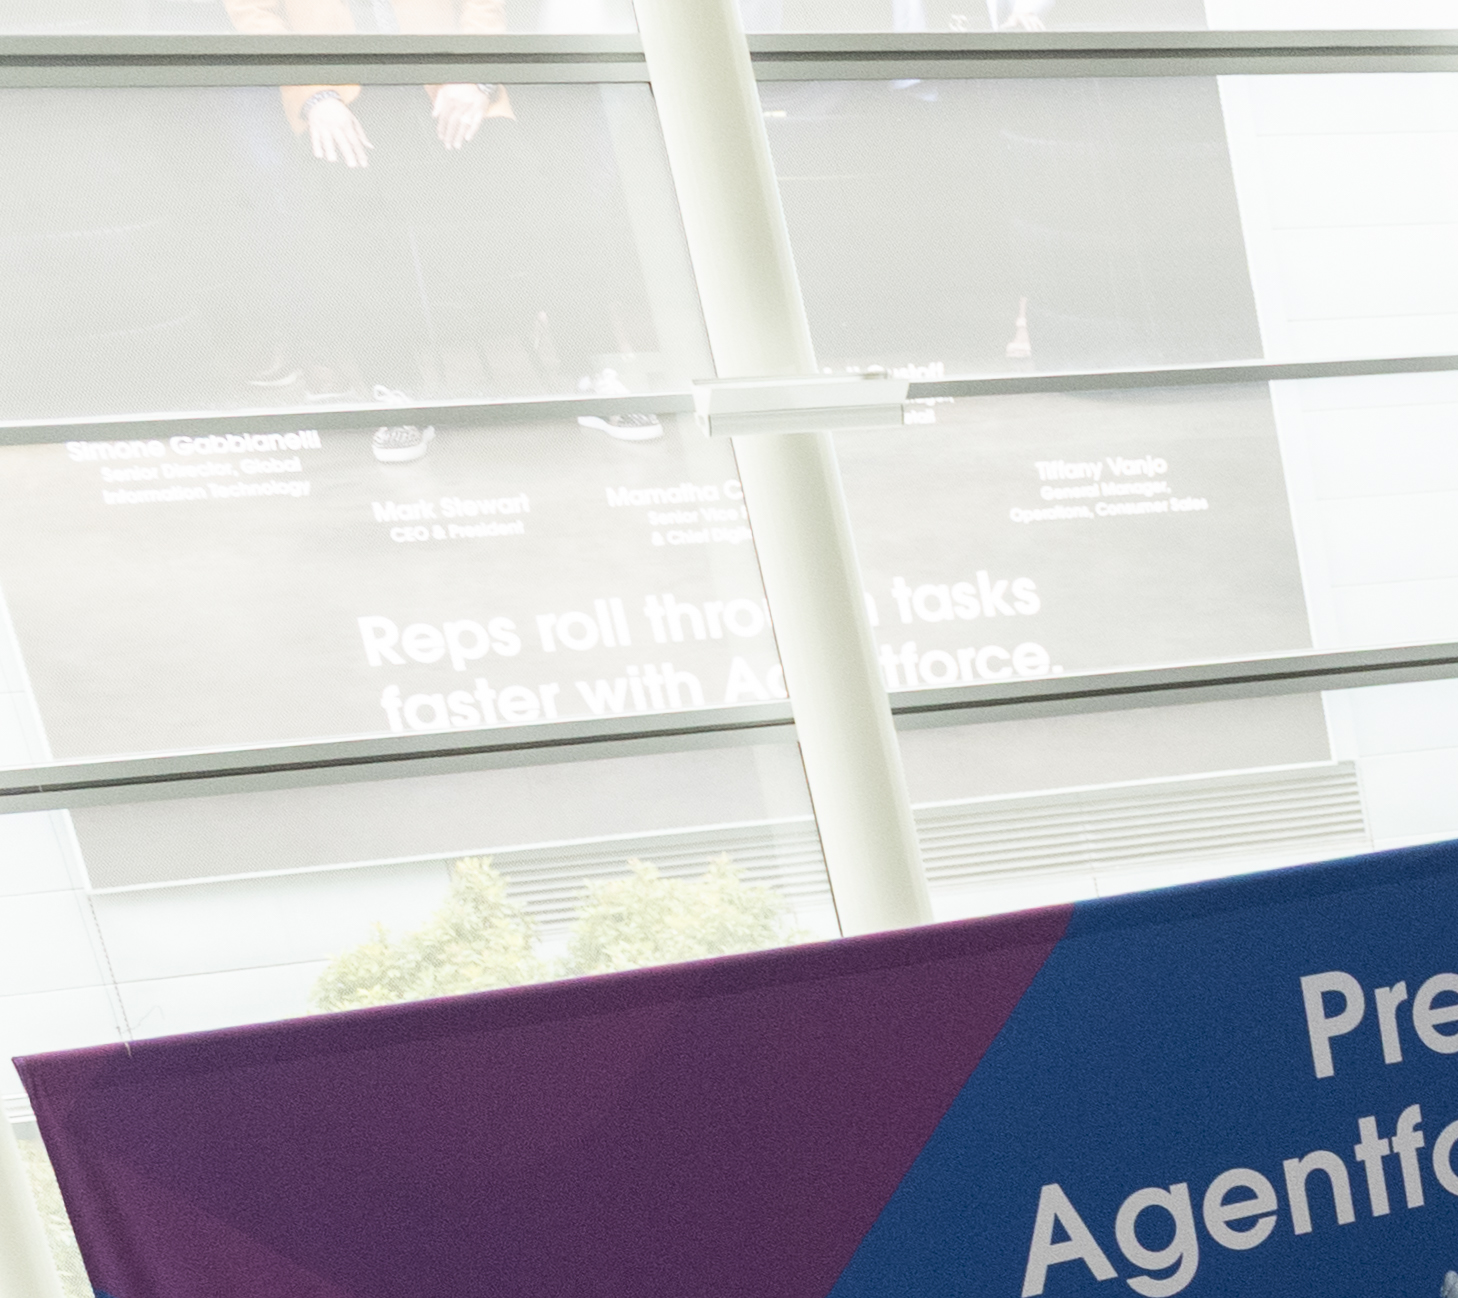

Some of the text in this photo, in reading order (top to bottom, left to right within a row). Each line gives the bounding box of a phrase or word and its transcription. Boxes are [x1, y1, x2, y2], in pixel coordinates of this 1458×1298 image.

[372, 493, 531, 523] Mark Stewart
[356, 615, 521, 673] Reps
[536, 597, 632, 655] roll
[890, 569, 1042, 626] tasks
[380, 678, 561, 734] faster
[577, 662, 704, 718] with
